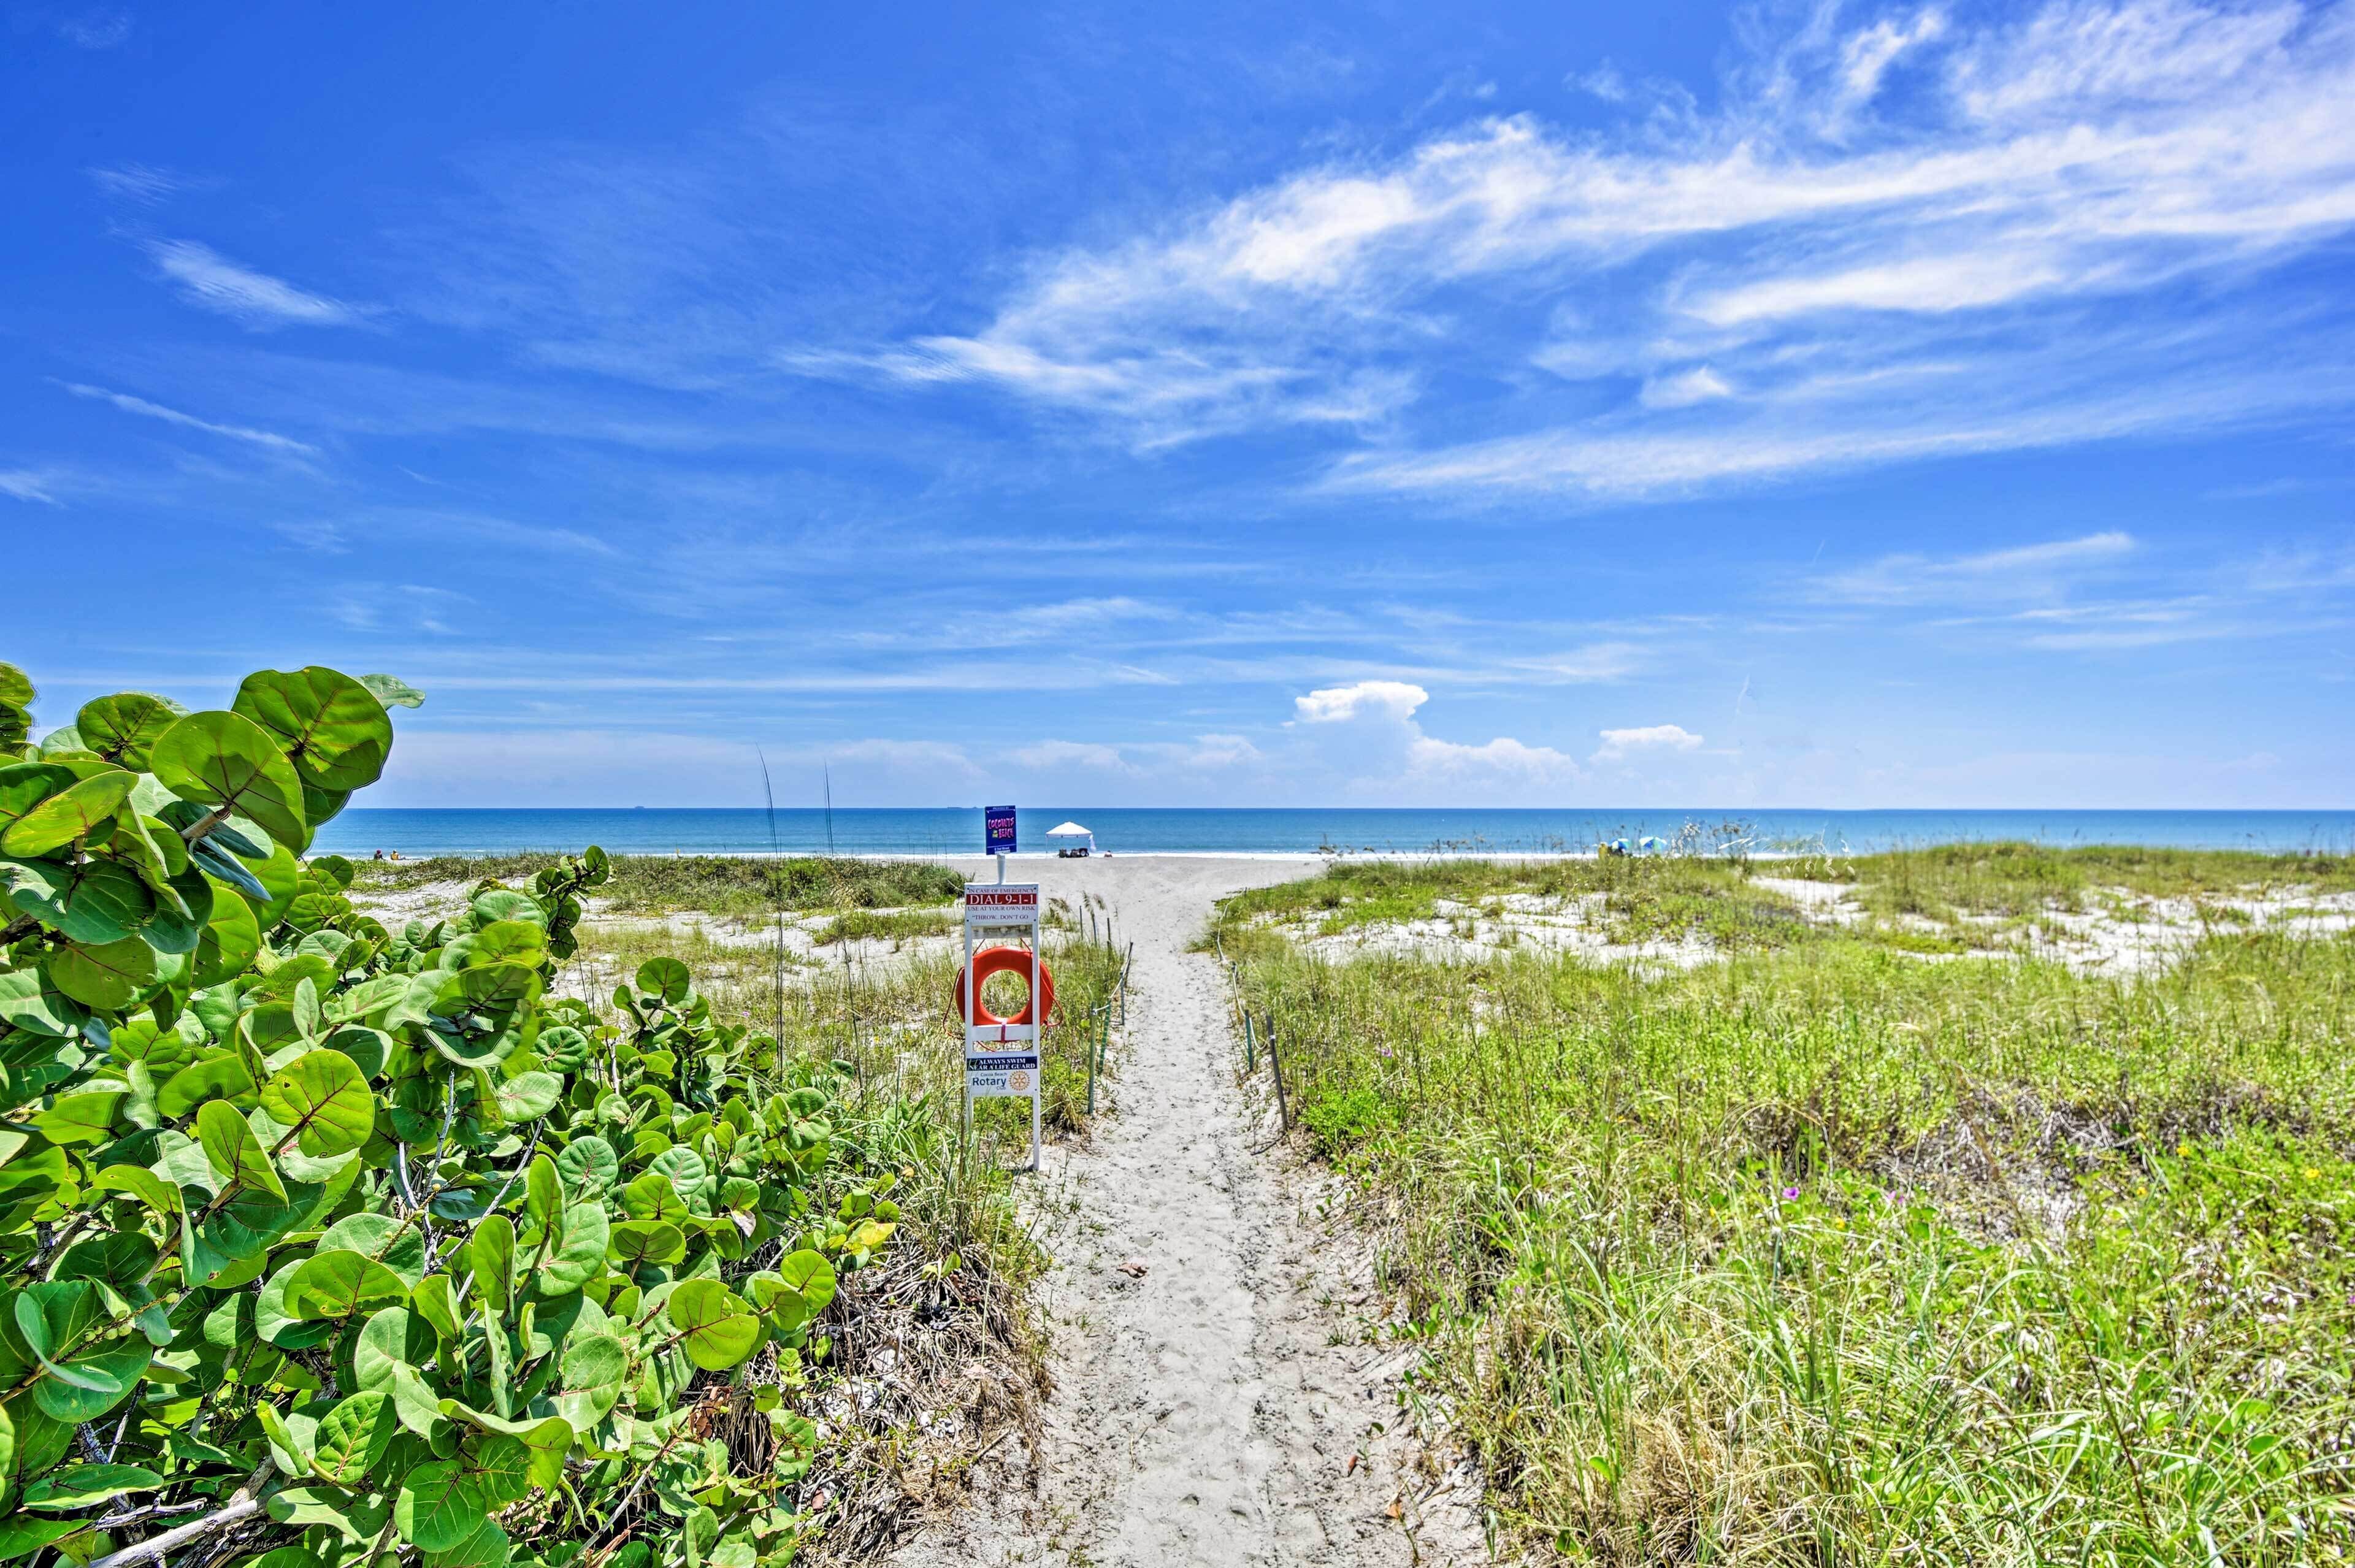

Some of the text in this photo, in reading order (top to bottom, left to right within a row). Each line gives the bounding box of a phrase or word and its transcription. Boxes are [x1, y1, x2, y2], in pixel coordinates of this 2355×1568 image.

[970, 894, 1034, 904] DIAL 9-1-1
[973, 1077, 1006, 1087] Rotary
